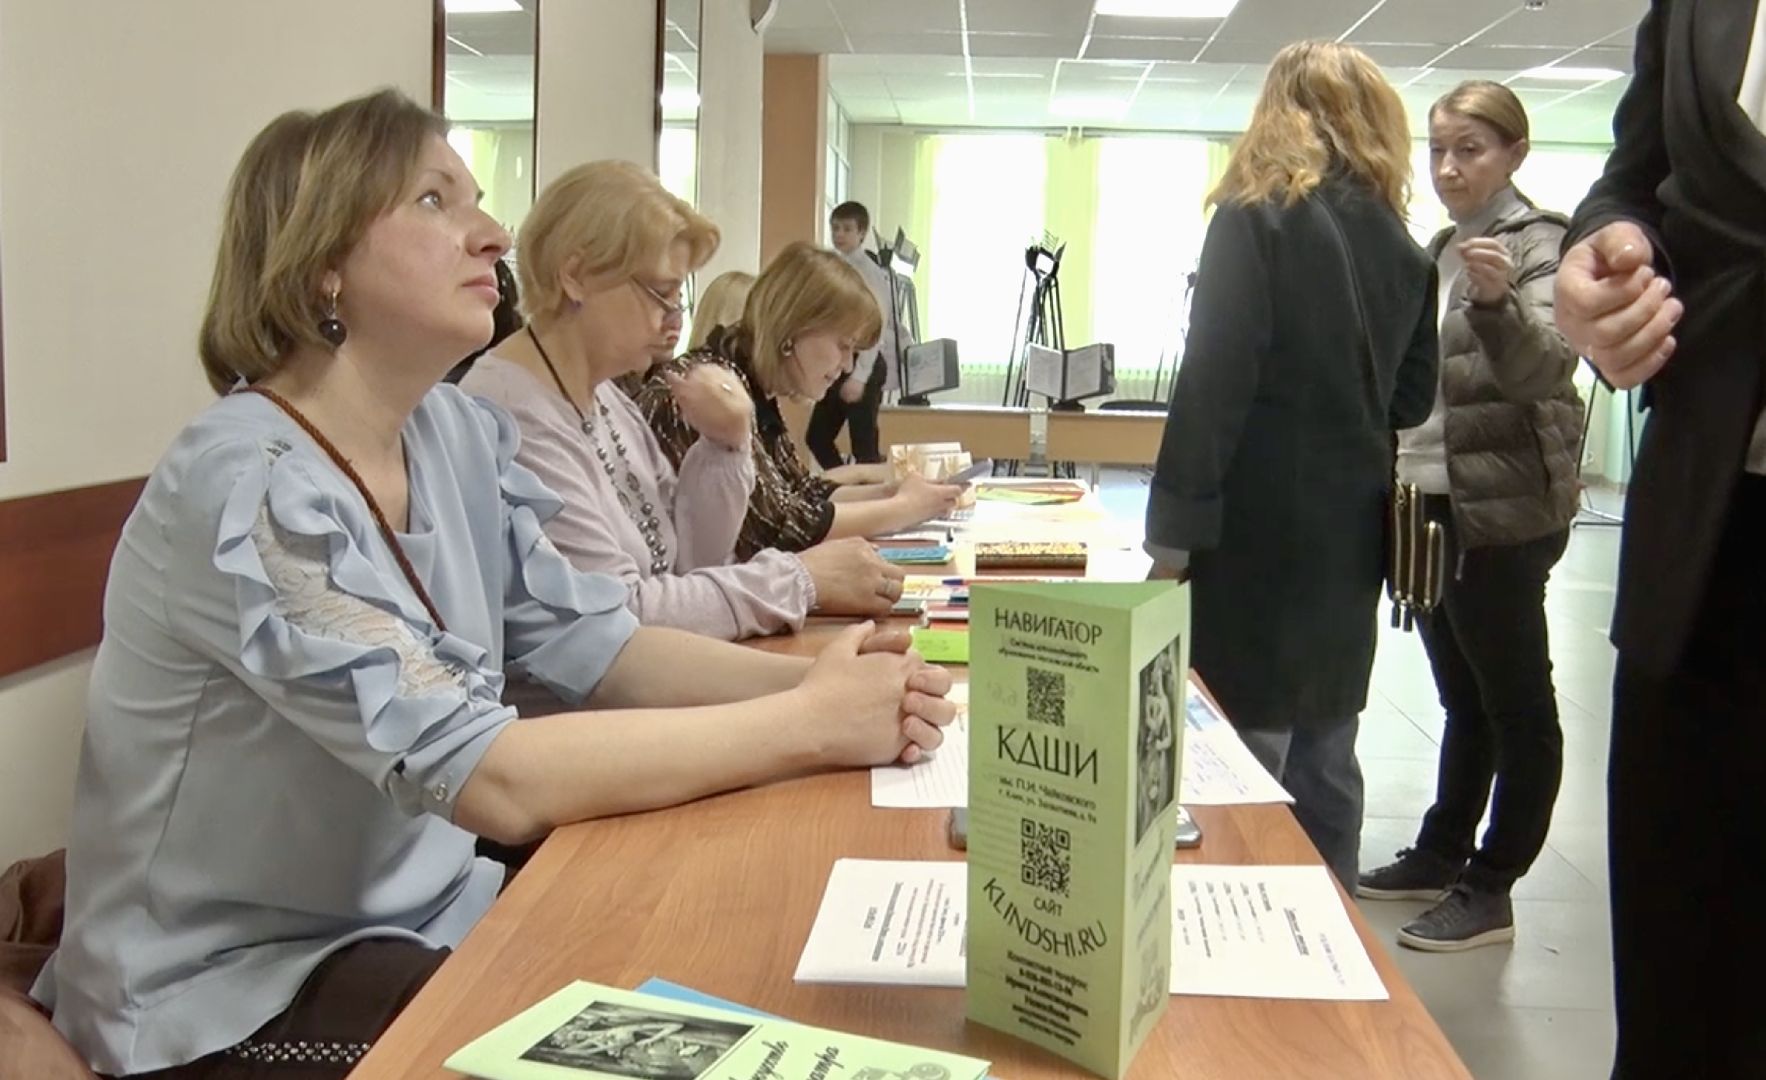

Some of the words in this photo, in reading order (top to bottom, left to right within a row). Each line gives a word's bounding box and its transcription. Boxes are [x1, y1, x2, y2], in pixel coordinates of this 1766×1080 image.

[994, 607, 1103, 645] НАВИГАТОР
[998, 724, 1098, 785] КДШИ
[983, 877, 1107, 957] KLINDSHI.RU
